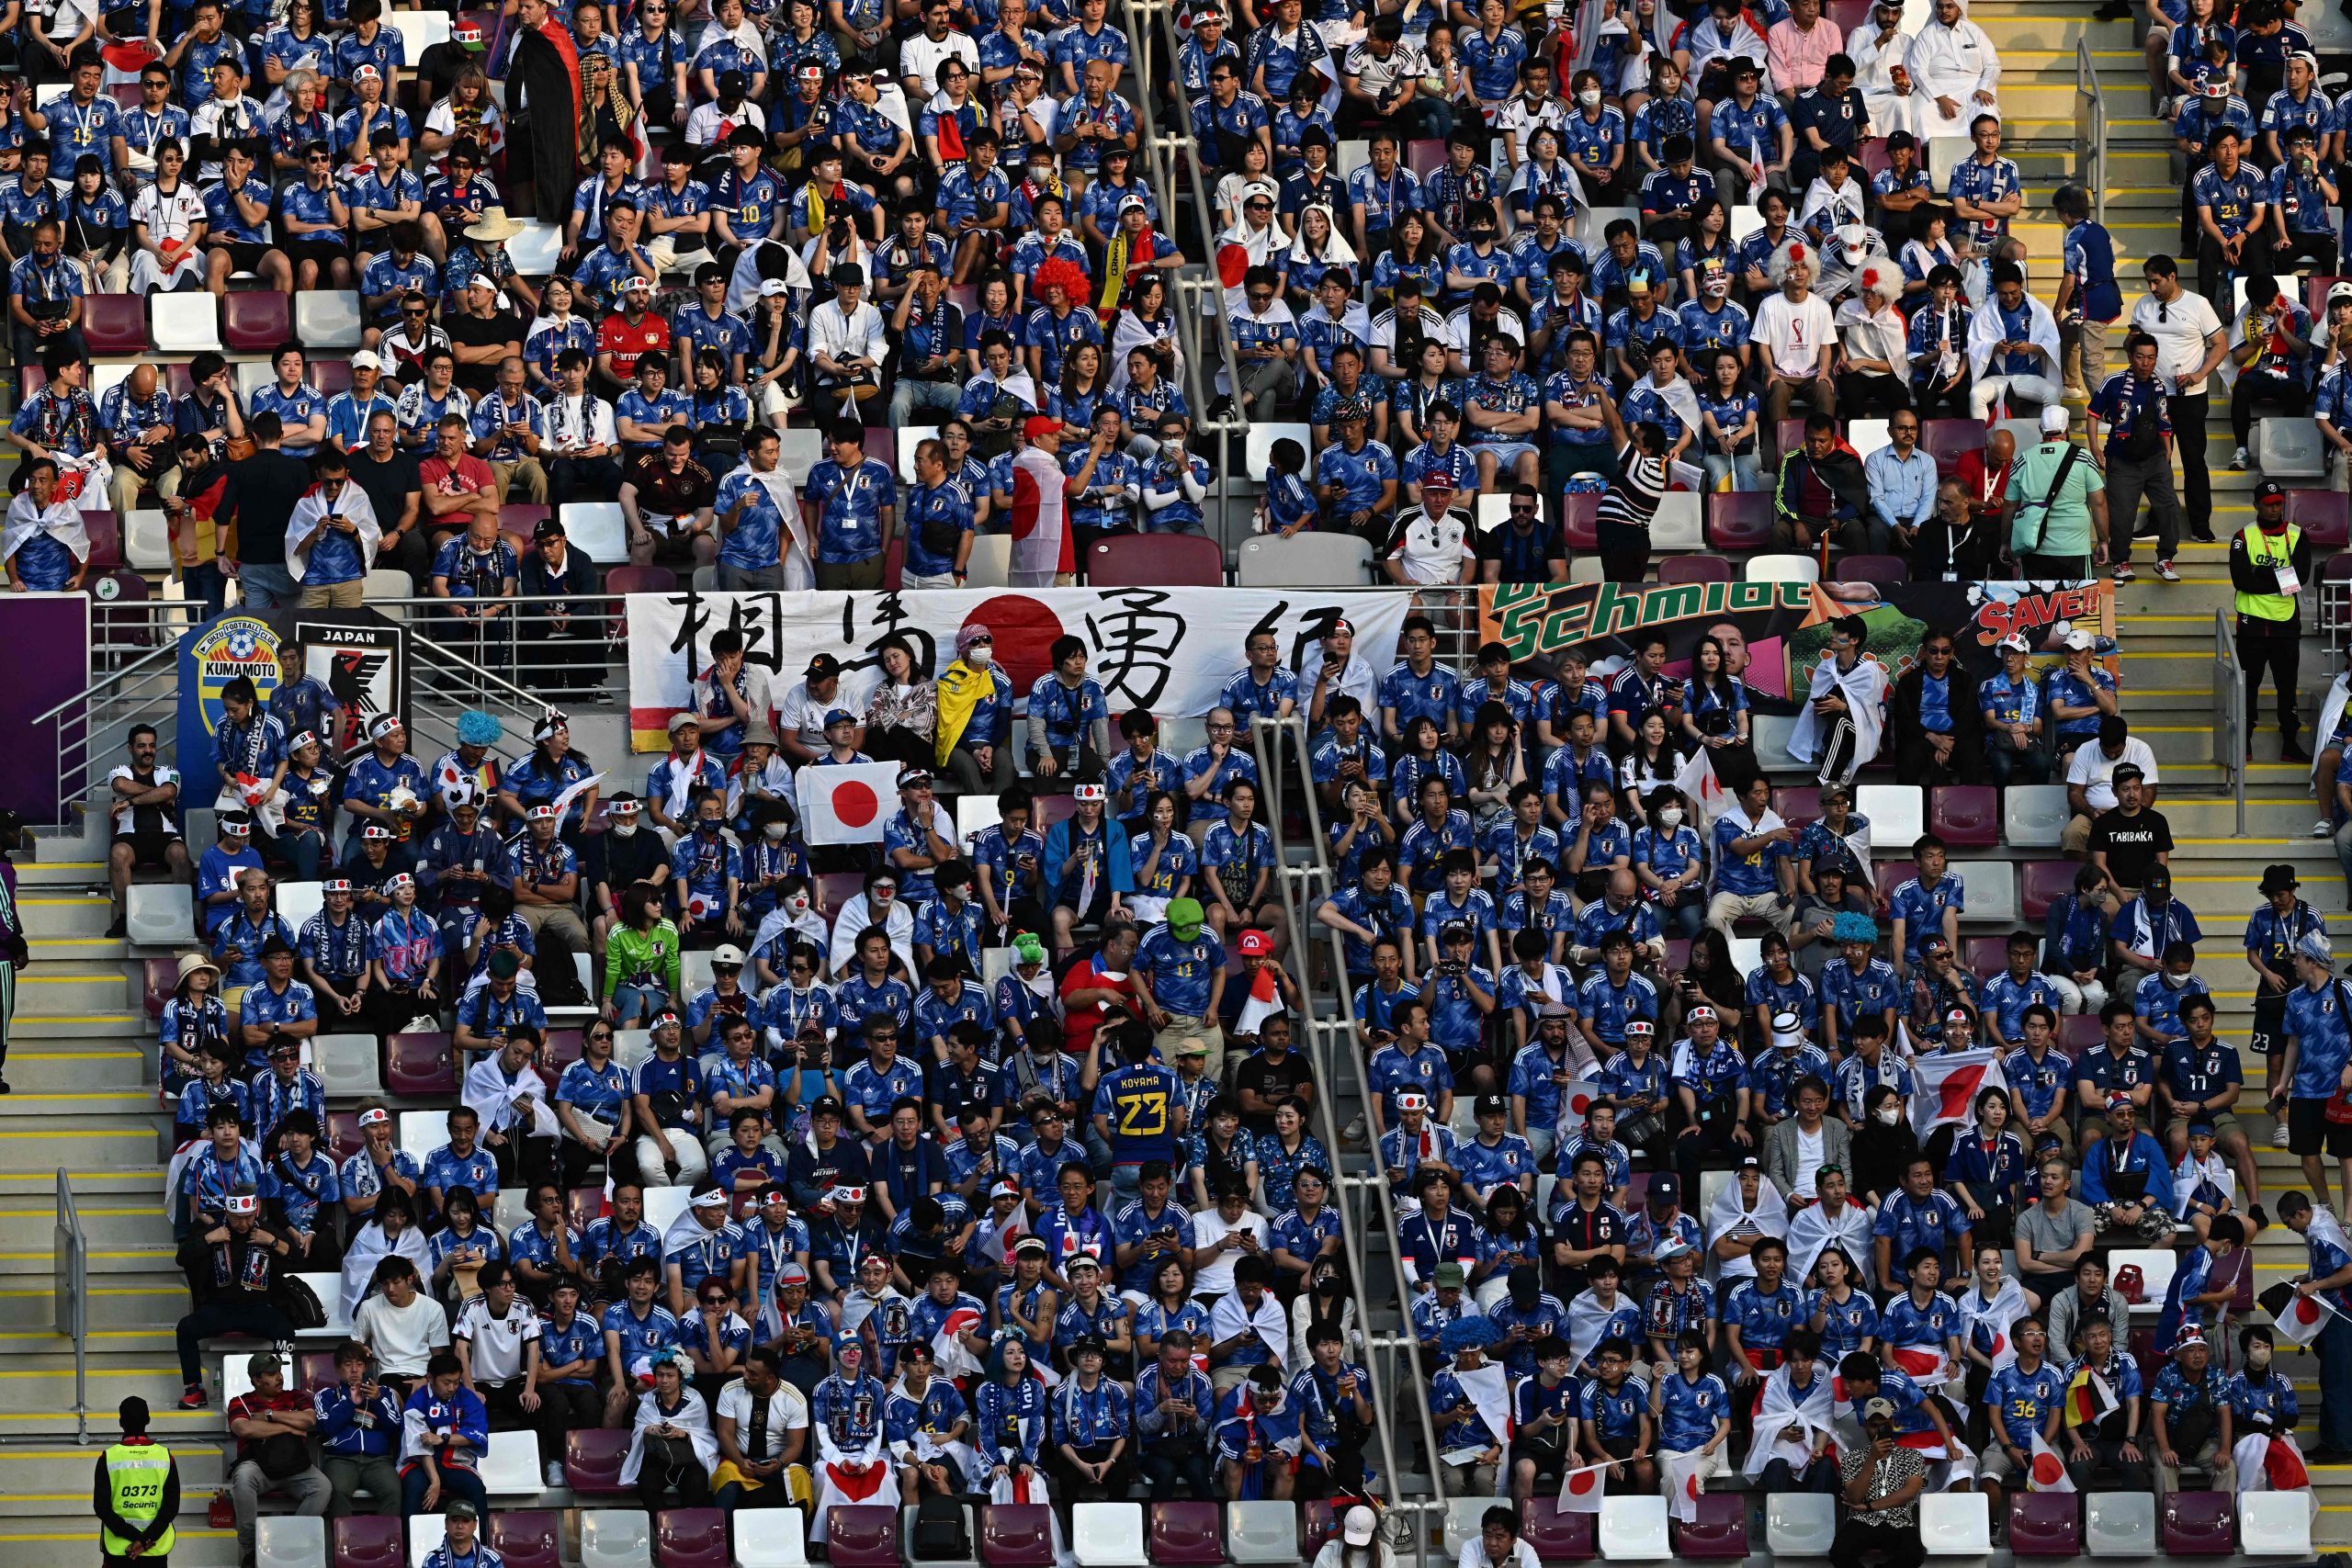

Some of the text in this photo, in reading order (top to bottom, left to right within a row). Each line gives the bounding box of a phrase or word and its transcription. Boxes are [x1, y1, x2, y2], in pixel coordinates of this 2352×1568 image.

[1589, 146, 1600, 164] 5
[741, 205, 760, 224] 10
[1977, 586, 2101, 647] SAVE!!
[207, 622, 277, 646] OHZU FOOTBALL CLUB
[322, 630, 376, 644] JAPAN
[206, 661, 276, 678] KUMAMOTO
[1077, 784, 1103, 797] 日本
[616, 801, 639, 812] 日本
[2109, 830, 2154, 843] TABIBAKA
[1005, 869, 1015, 887] 9
[1152, 872, 1172, 891] 14
[1177, 963, 1192, 977] 11
[1690, 1007, 1714, 1020] 日本
[2254, 1032, 2269, 1051] 23
[1121, 1076, 1159, 1089] KOYAMA
[1116, 1091, 1168, 1136] 23
[2012, 1400, 2036, 1417] 36
[121, 1484, 157, 1497] 0373
[122, 1499, 158, 1509] Security
